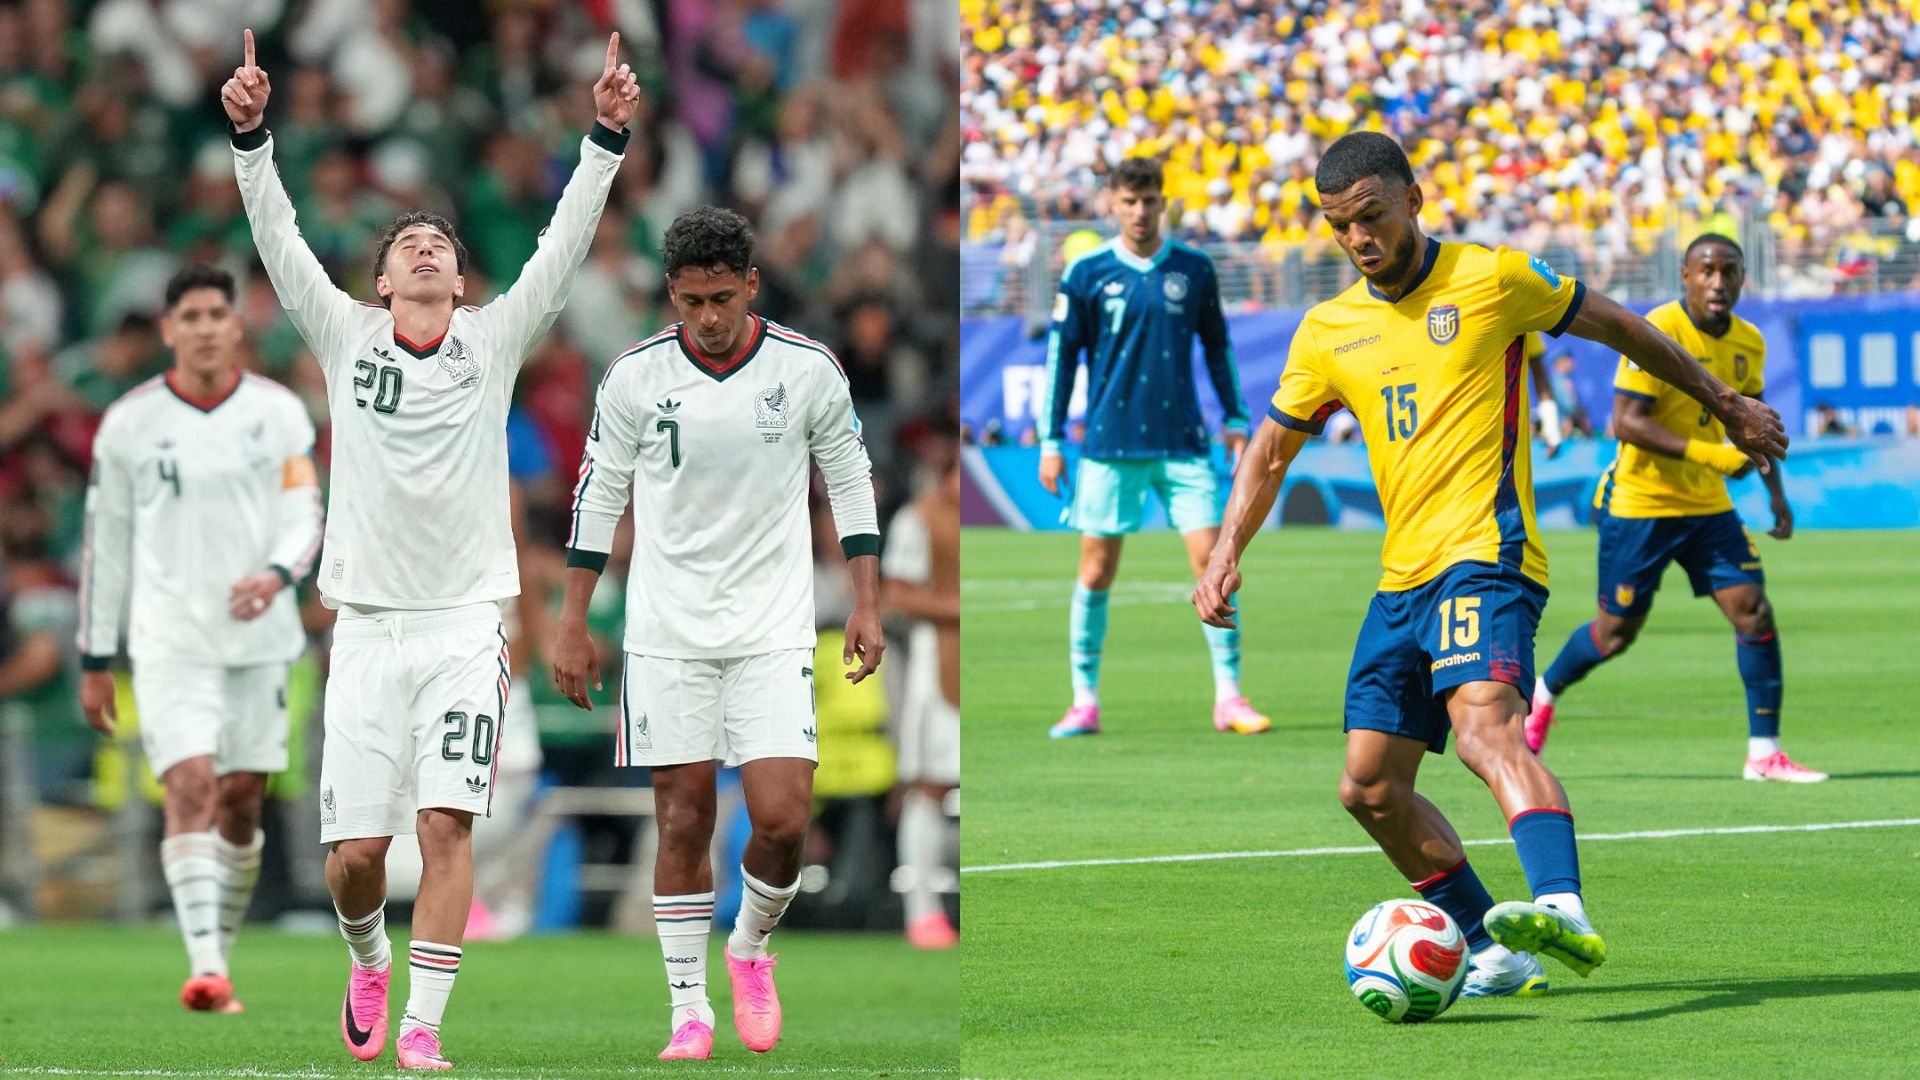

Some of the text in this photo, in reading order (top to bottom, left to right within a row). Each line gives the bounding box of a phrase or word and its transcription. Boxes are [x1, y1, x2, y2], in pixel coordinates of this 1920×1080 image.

[1104, 297, 1126, 334] 7
[1334, 334, 1381, 357] marathon
[353, 359, 404, 414] 20
[1380, 383, 1418, 442] 15
[656, 420, 680, 468] 7
[157, 459, 180, 497] 4
[1439, 597, 1481, 651] 15
[442, 711, 493, 765] 20
